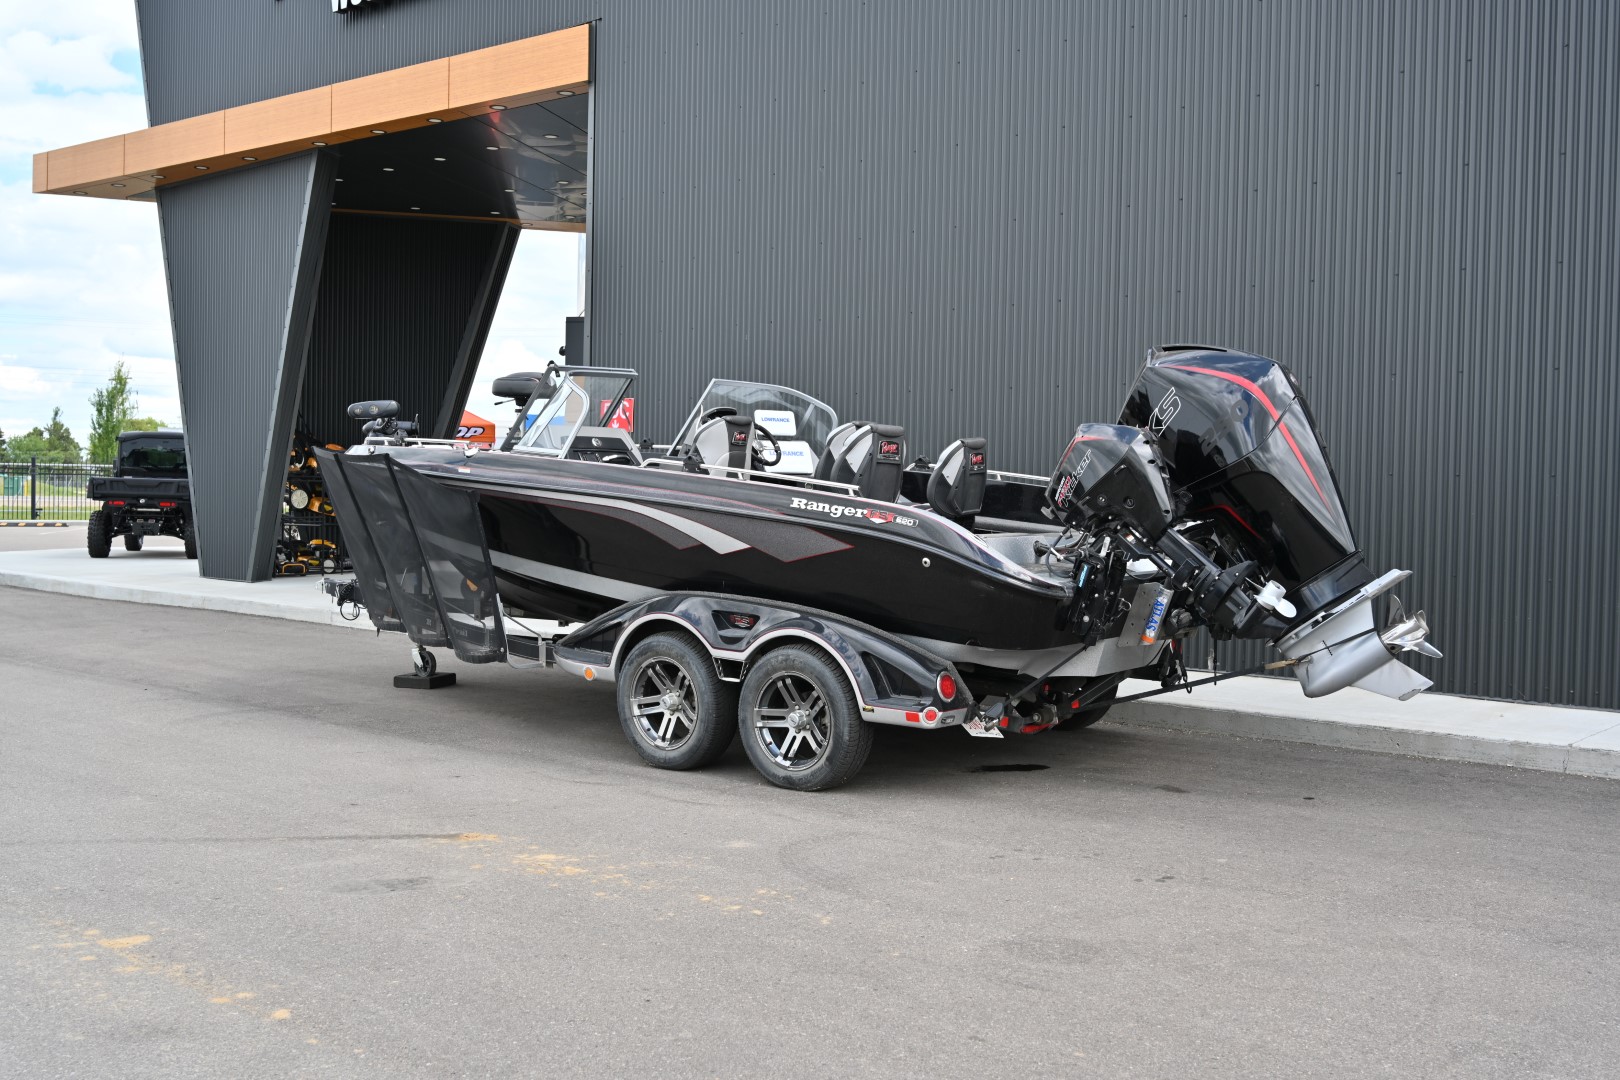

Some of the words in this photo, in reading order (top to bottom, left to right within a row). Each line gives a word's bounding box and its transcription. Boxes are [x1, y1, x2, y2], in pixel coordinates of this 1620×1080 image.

[789, 497, 868, 518] Ranger
[895, 515, 914, 527] 620
[1145, 598, 1165, 632] ATLAS
